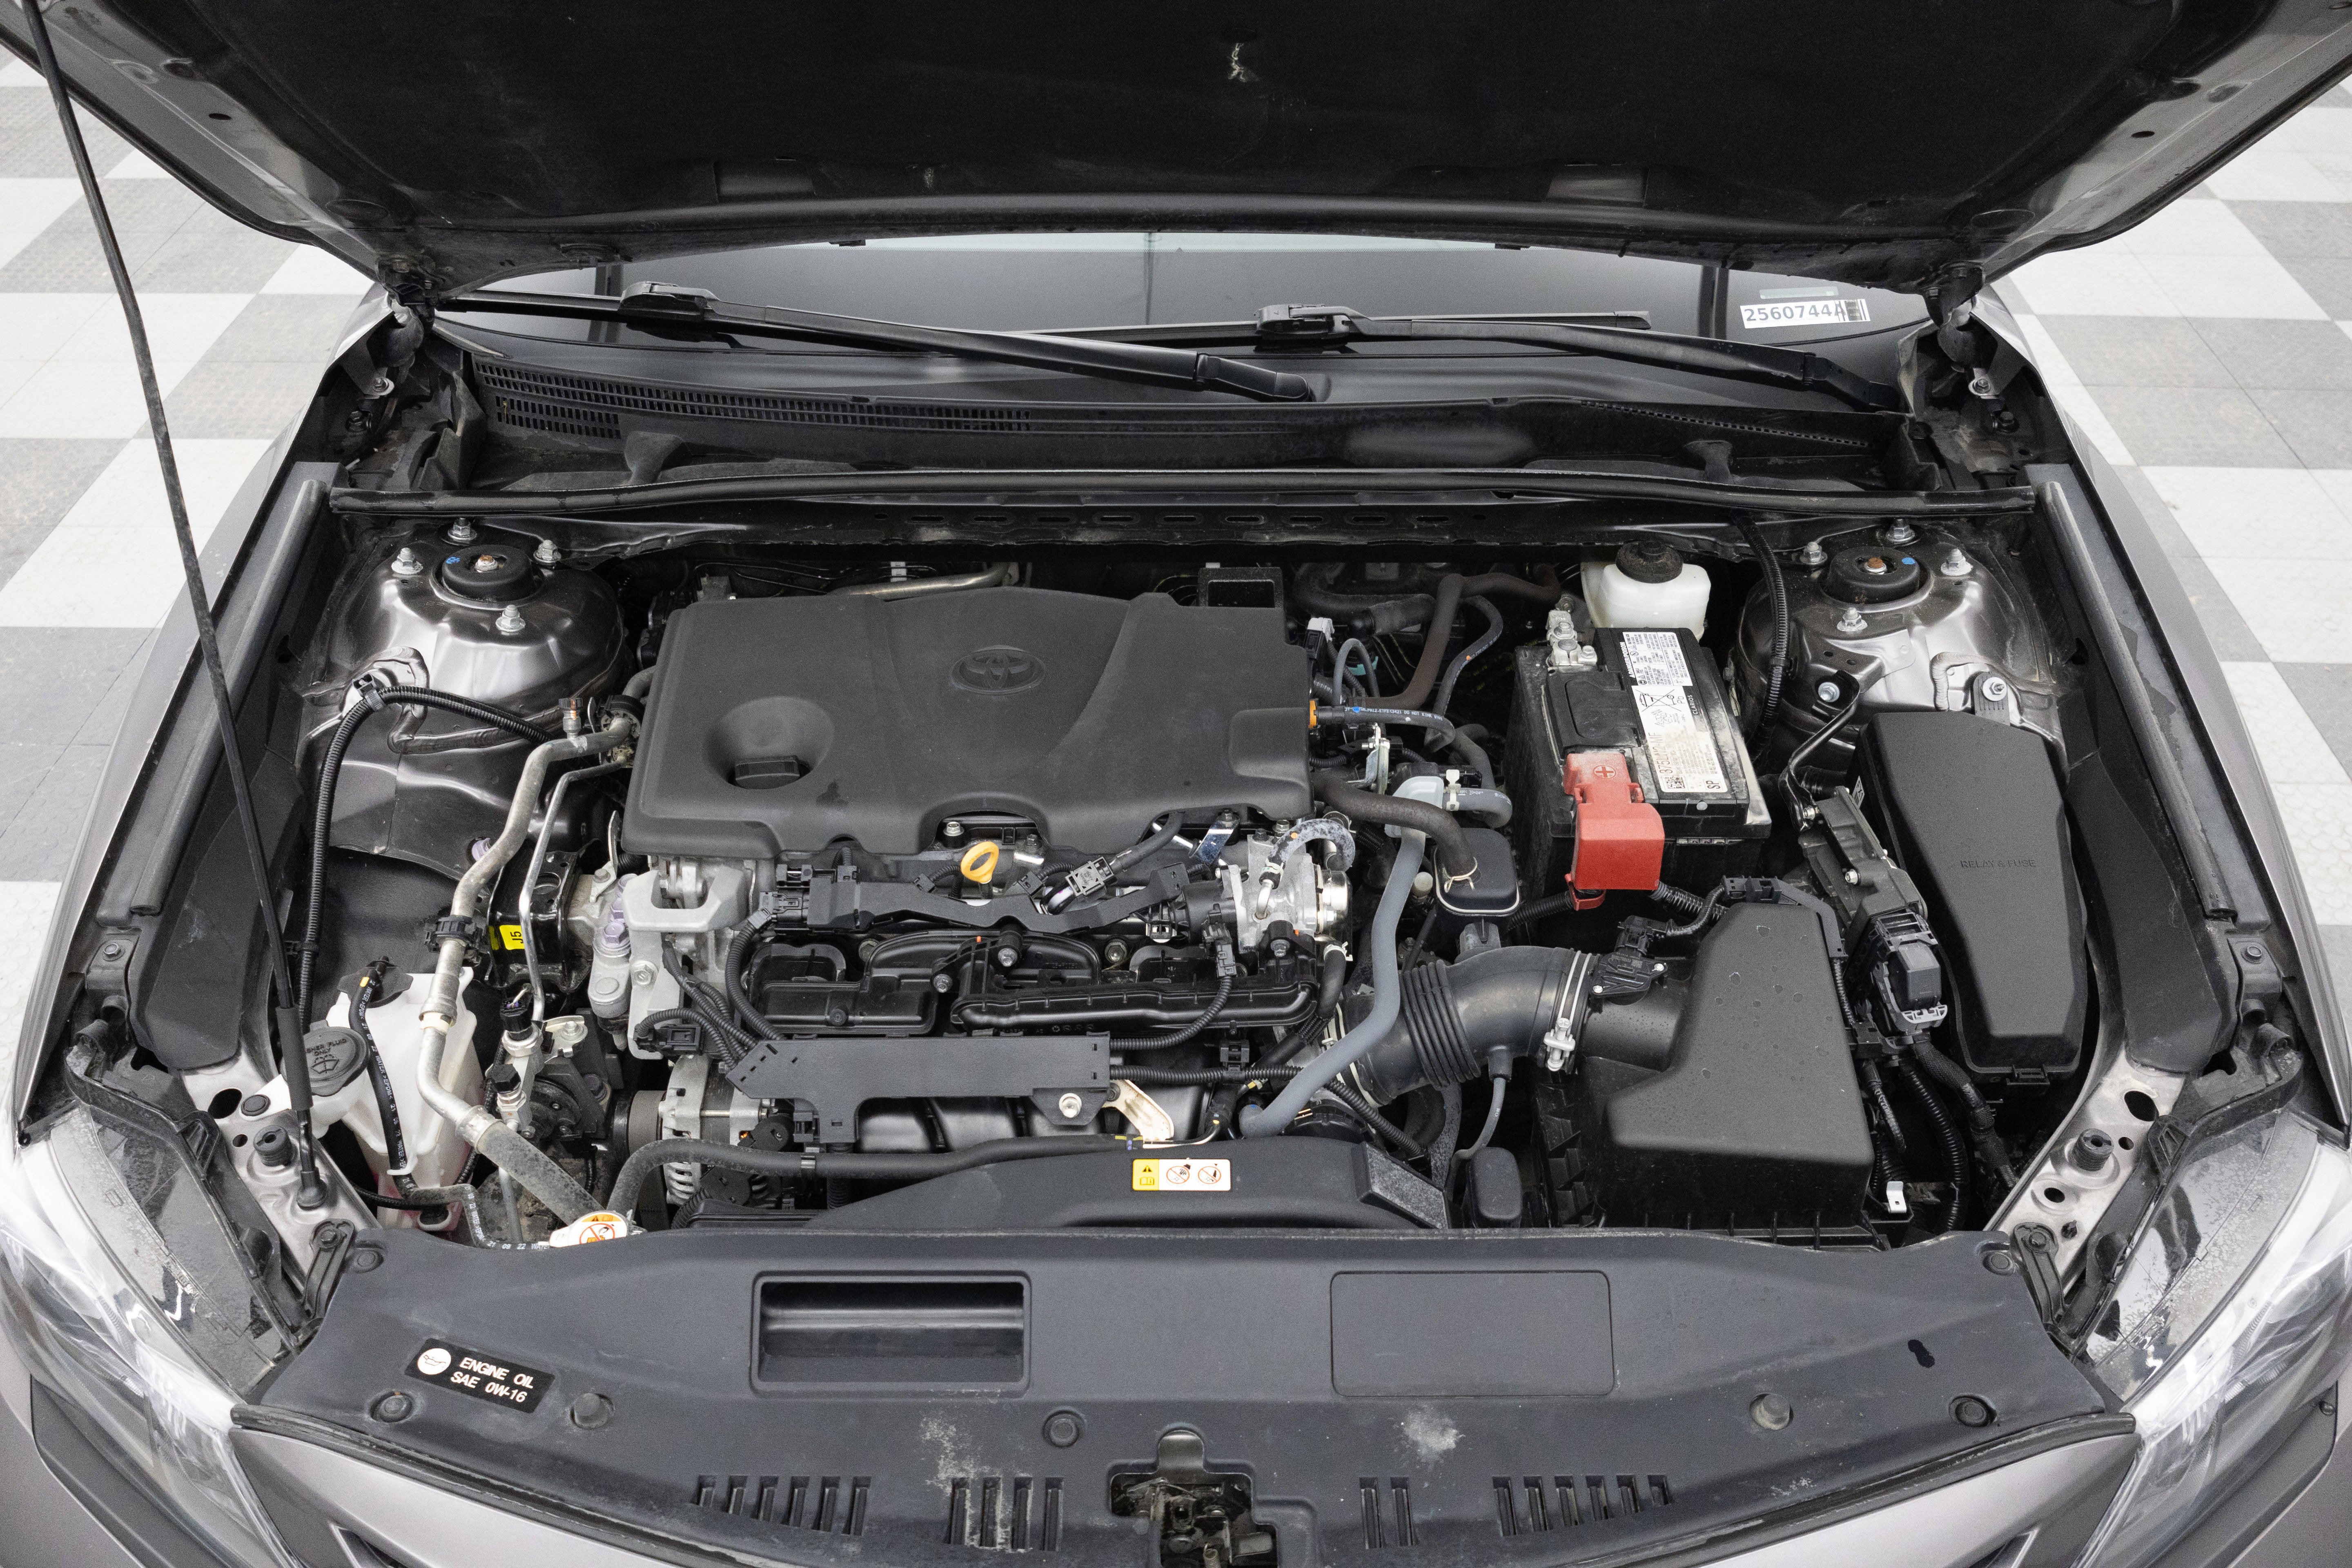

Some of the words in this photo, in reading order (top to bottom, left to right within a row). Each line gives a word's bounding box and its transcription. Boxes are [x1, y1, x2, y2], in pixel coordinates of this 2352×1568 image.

[1744, 303, 1847, 322] 2560744A
[1688, 695, 1698, 715] CLARIOS
[1707, 780, 1721, 789] SP
[1960, 860, 1994, 868] RELAY
[2008, 859, 2037, 867] FUSE
[362, 987, 373, 1002] WATER
[375, 1056, 385, 1074] WATER
[459, 1357, 510, 1380] ENGINE
[513, 1373, 534, 1389] OIL
[450, 1371, 481, 1388] SAE
[485, 1382, 528, 1403] 0W-16
